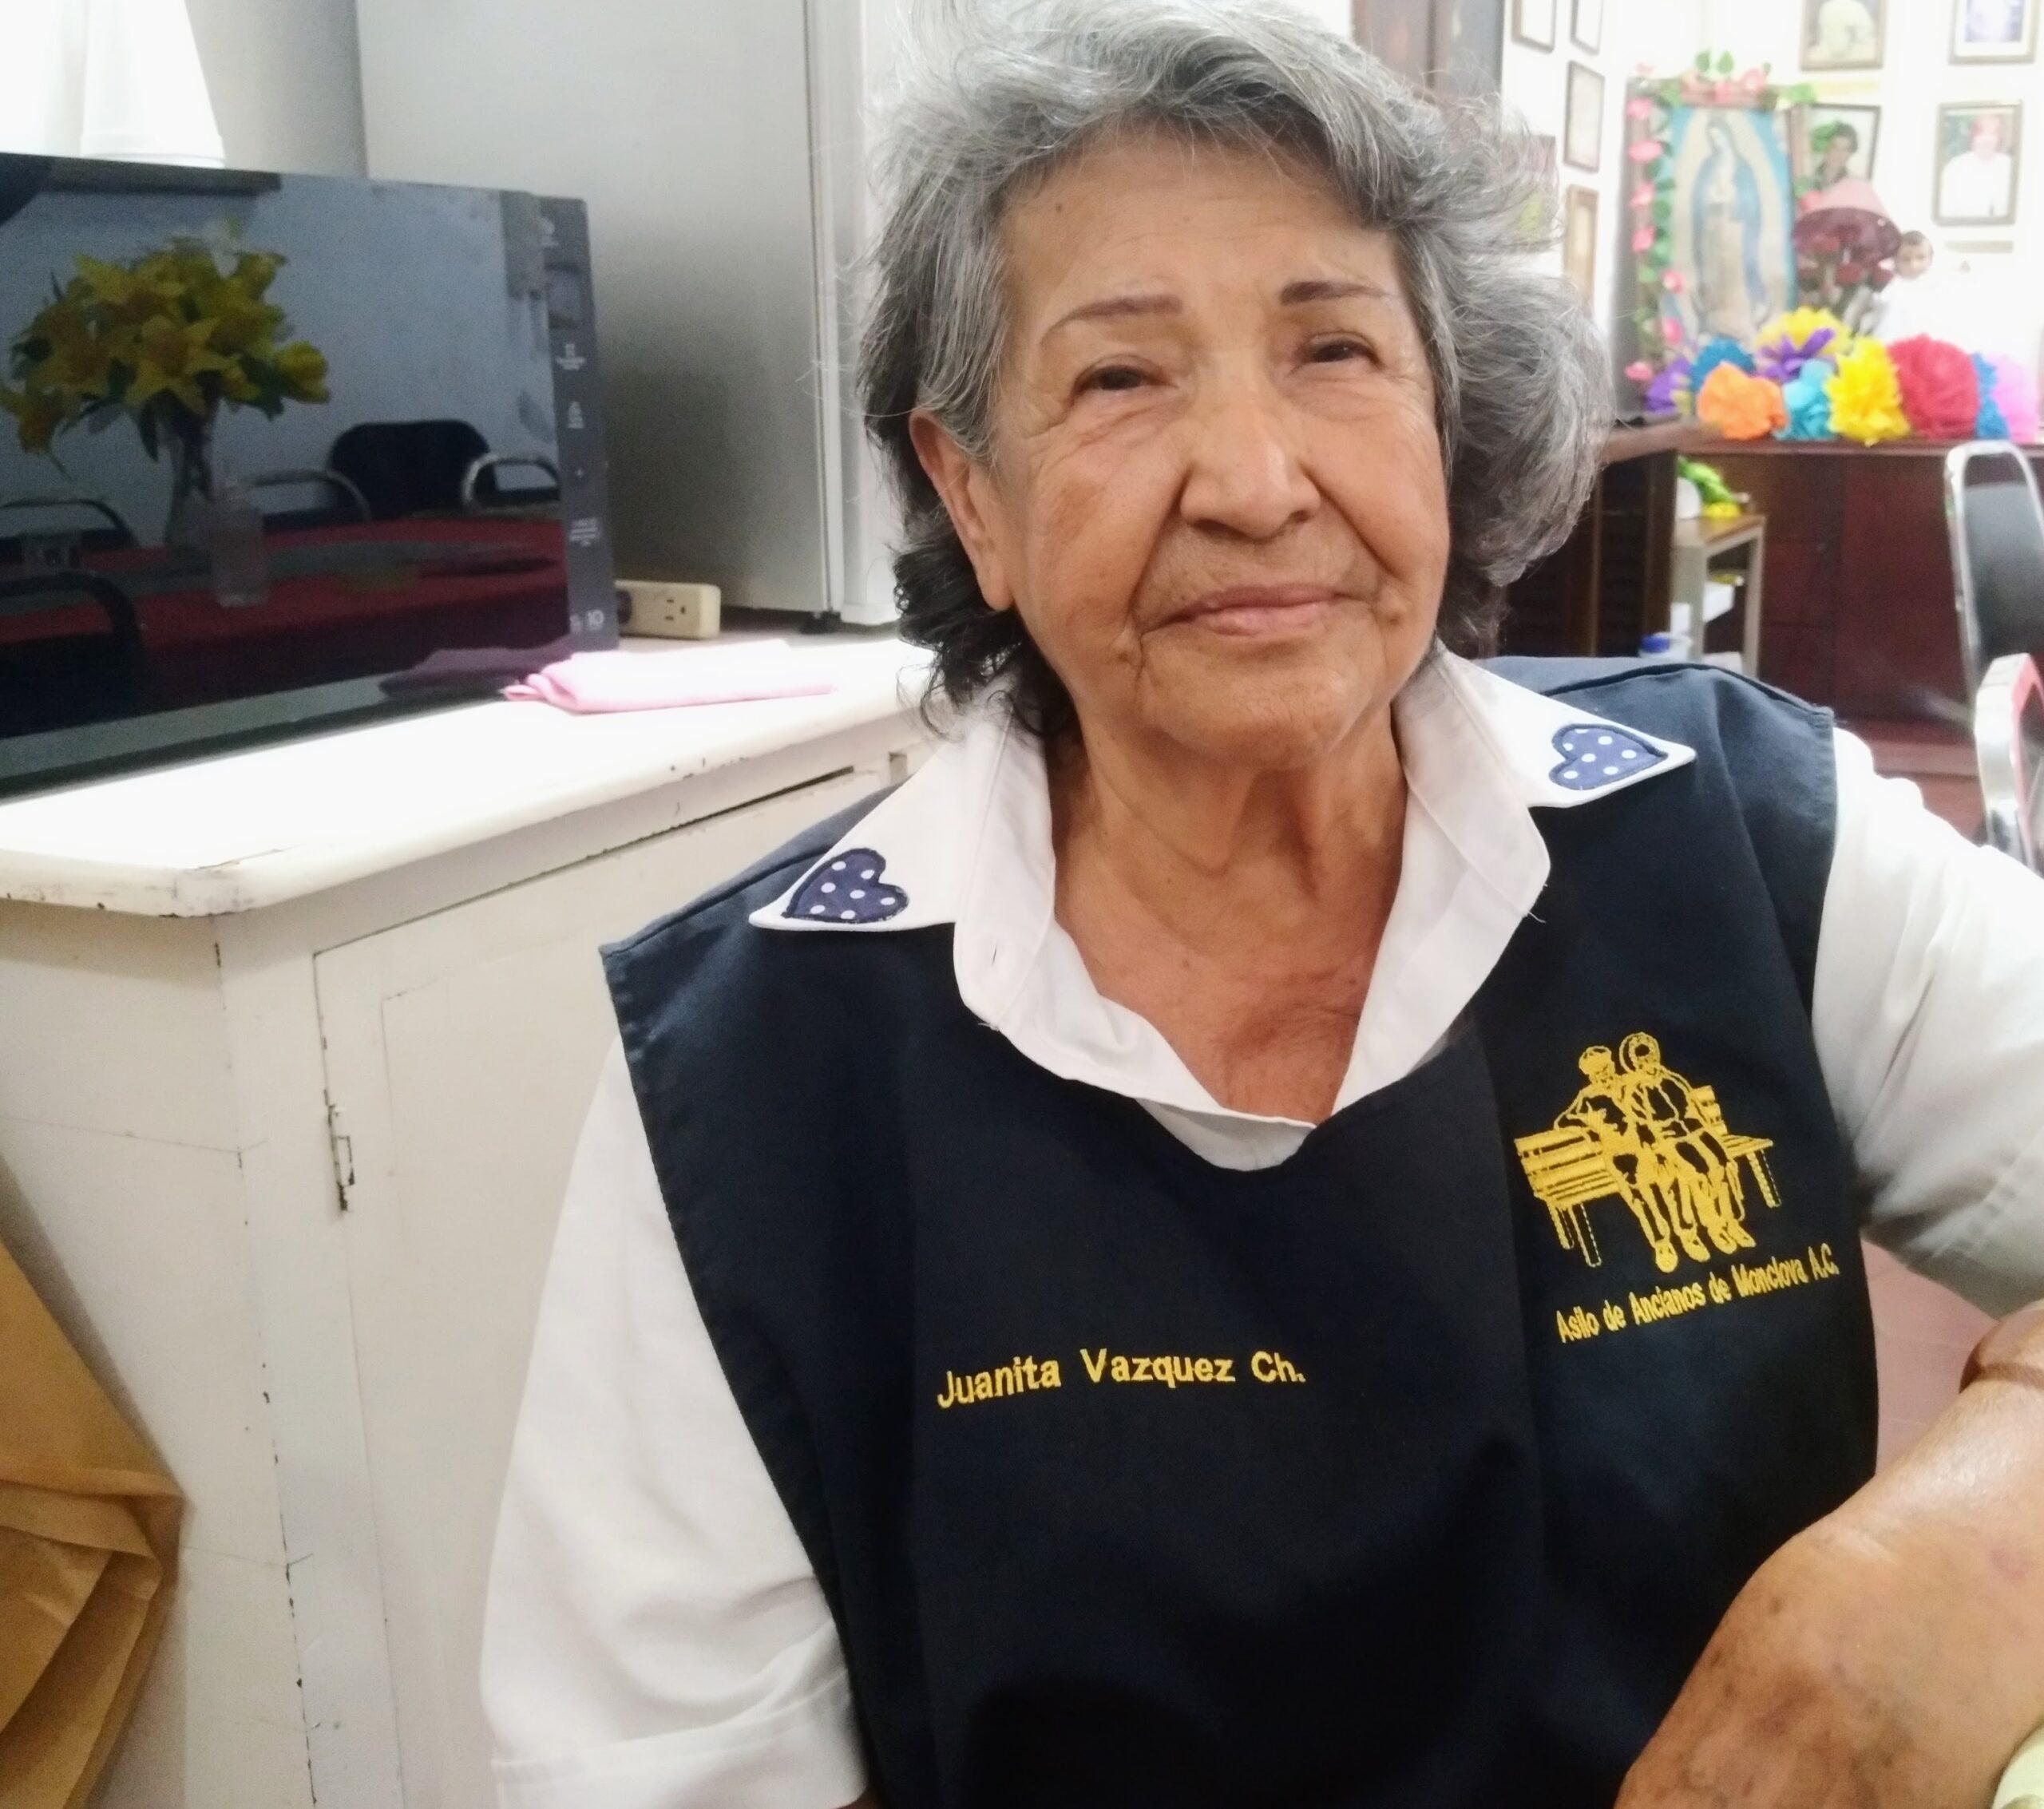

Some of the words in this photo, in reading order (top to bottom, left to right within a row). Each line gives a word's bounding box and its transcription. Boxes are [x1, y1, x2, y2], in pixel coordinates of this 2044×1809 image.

[1555, 1305, 1601, 1344] Asilo
[1602, 1299, 1627, 1332] de
[1628, 1285, 1707, 1326] Ancianos
[1707, 1271, 1733, 1304] de
[1730, 1255, 1809, 1297] Monclova
[1808, 1242, 1840, 1281] A.C.
[937, 1356, 1062, 1409] Juanita
[1079, 1348, 1236, 1389] Vazquez
[1250, 1350, 1306, 1383] Ch.
